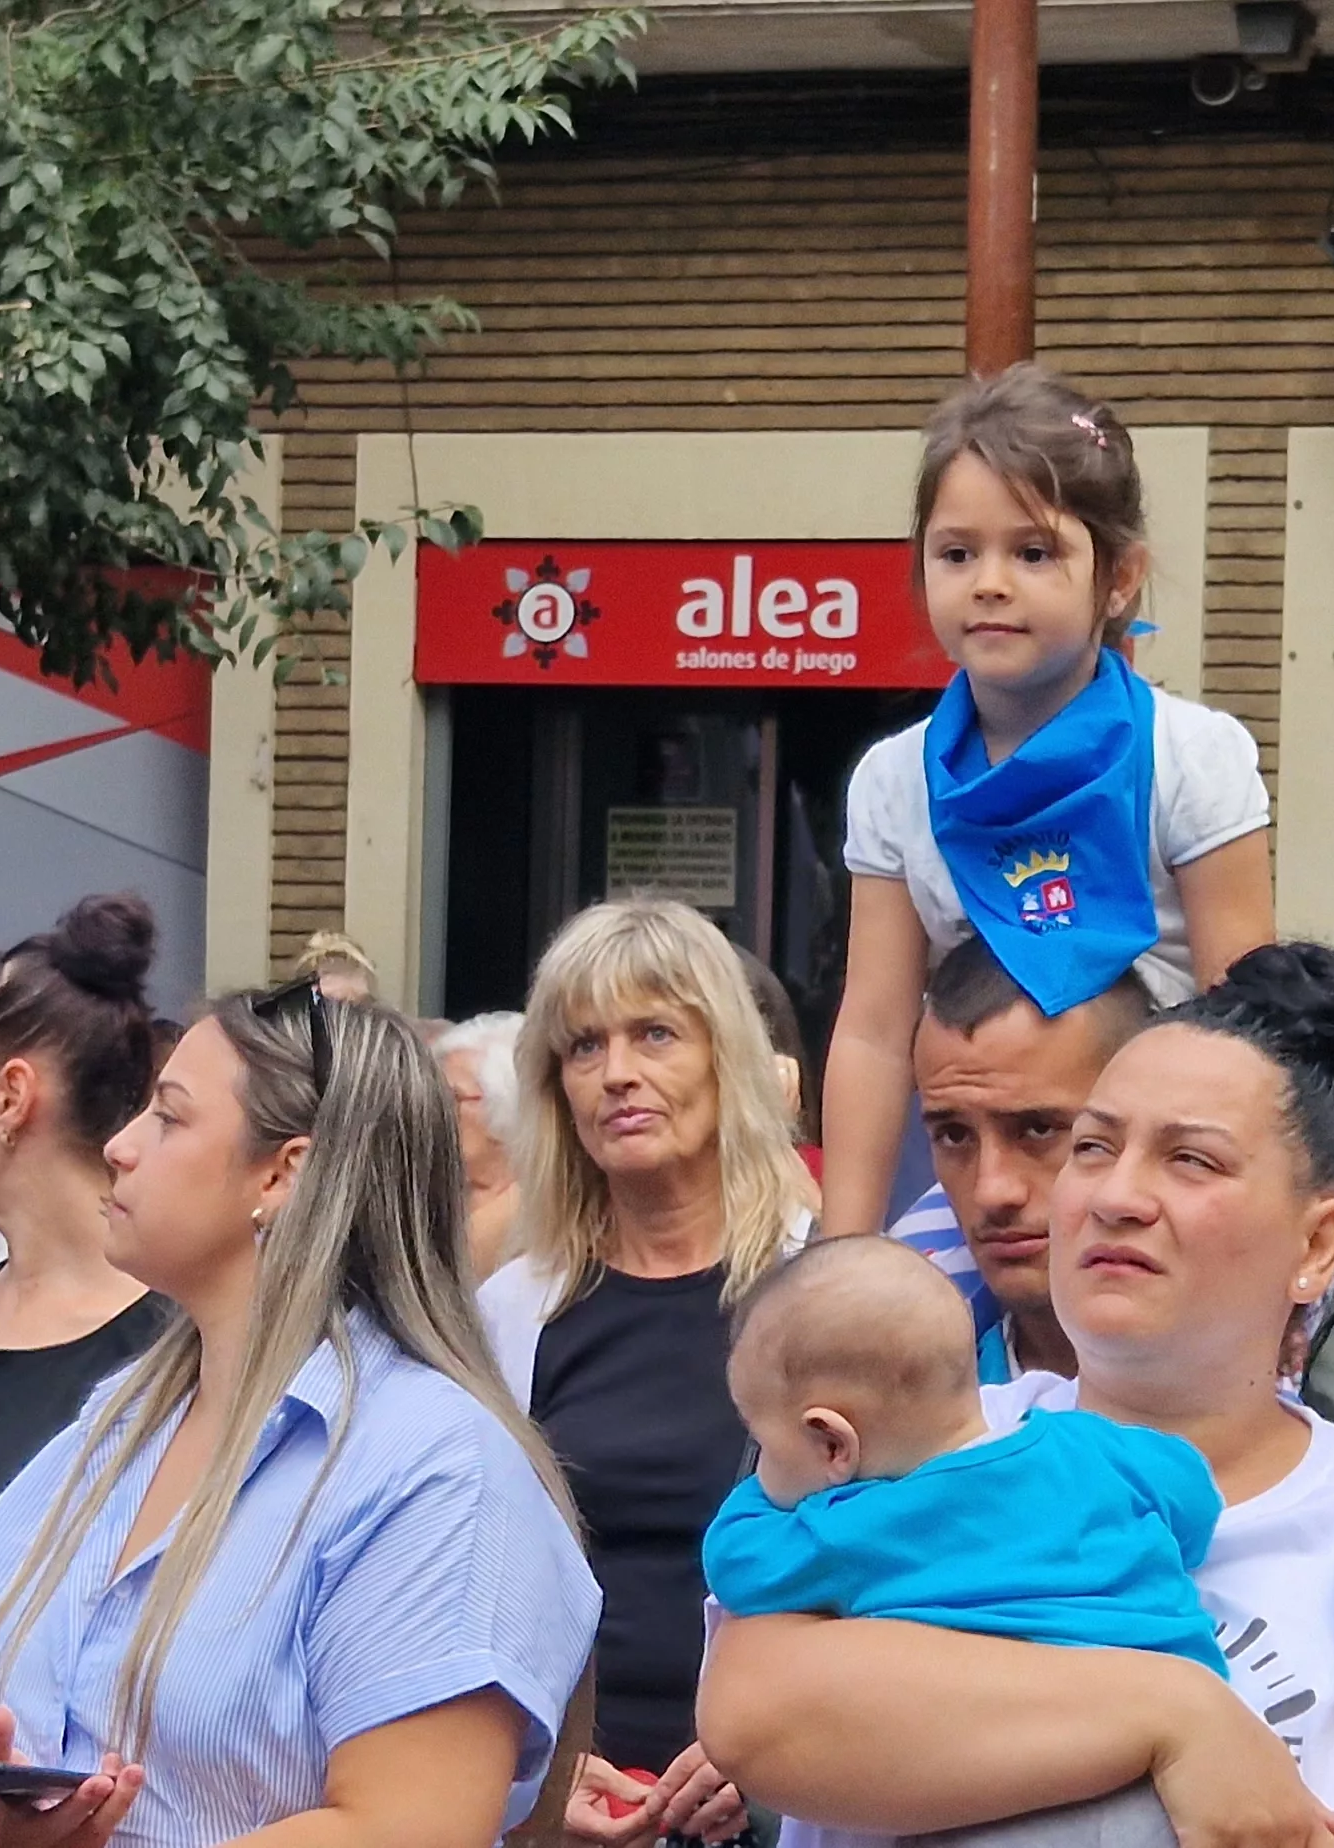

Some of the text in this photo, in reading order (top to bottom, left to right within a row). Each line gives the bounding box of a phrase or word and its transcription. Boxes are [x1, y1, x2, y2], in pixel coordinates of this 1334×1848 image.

[533, 594, 559, 629] a
[676, 555, 860, 638] alea
[676, 647, 857, 675] salones de juego
